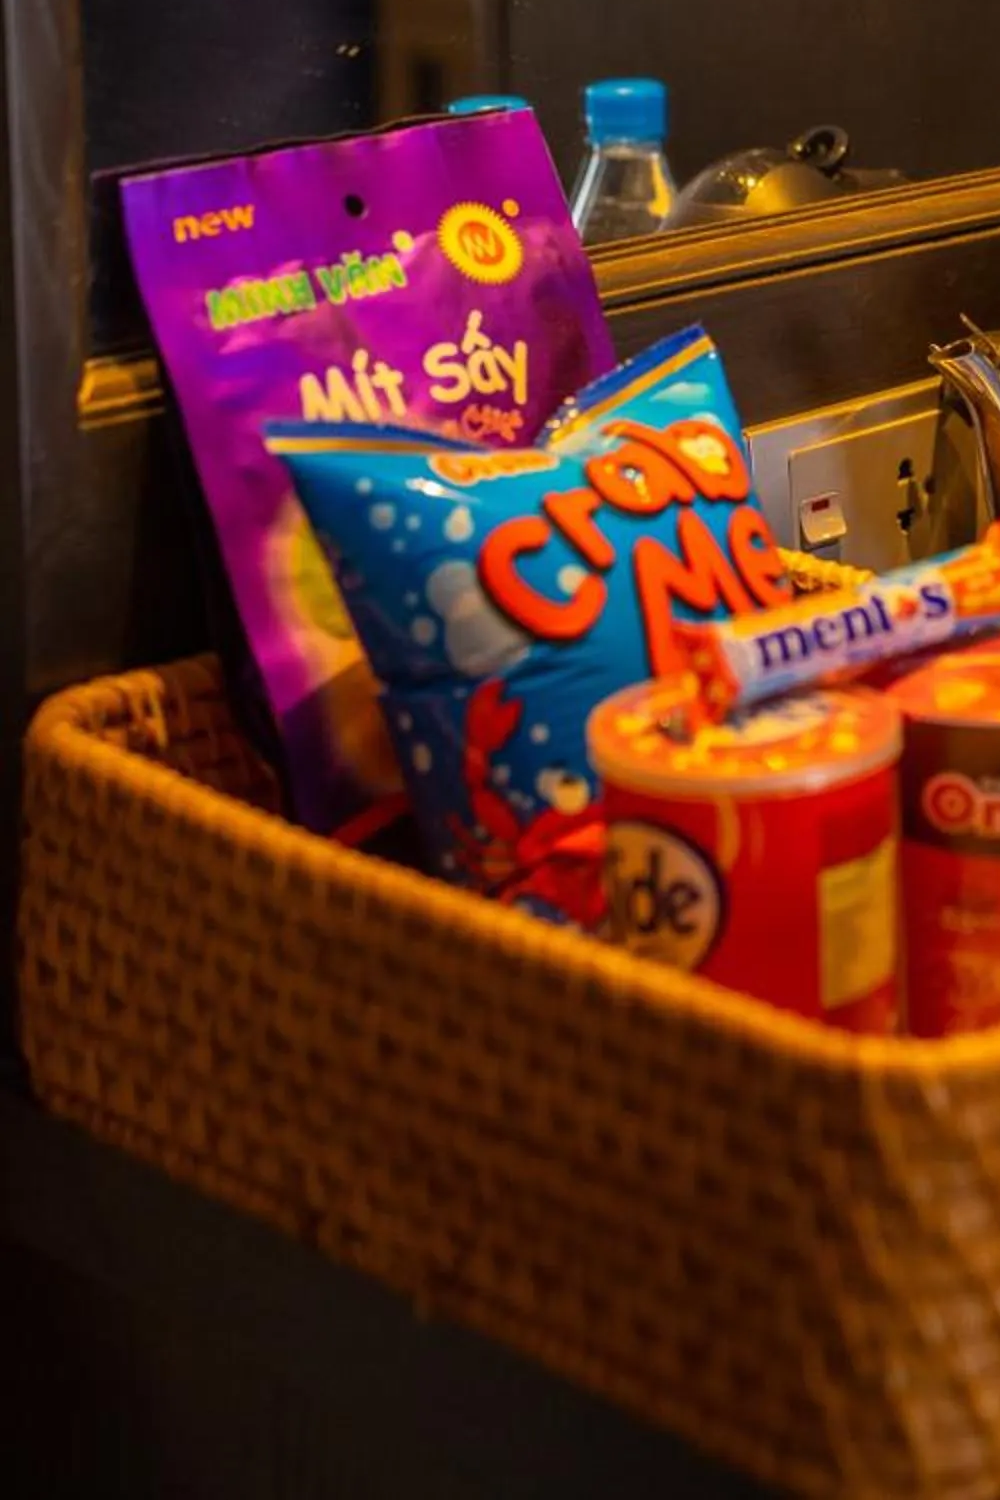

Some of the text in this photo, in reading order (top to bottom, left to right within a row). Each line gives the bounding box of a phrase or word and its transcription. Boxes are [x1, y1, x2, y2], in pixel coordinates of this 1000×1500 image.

[173, 204, 255, 242] new
[477, 417, 751, 640] Crab
[633, 506, 794, 681] Me
